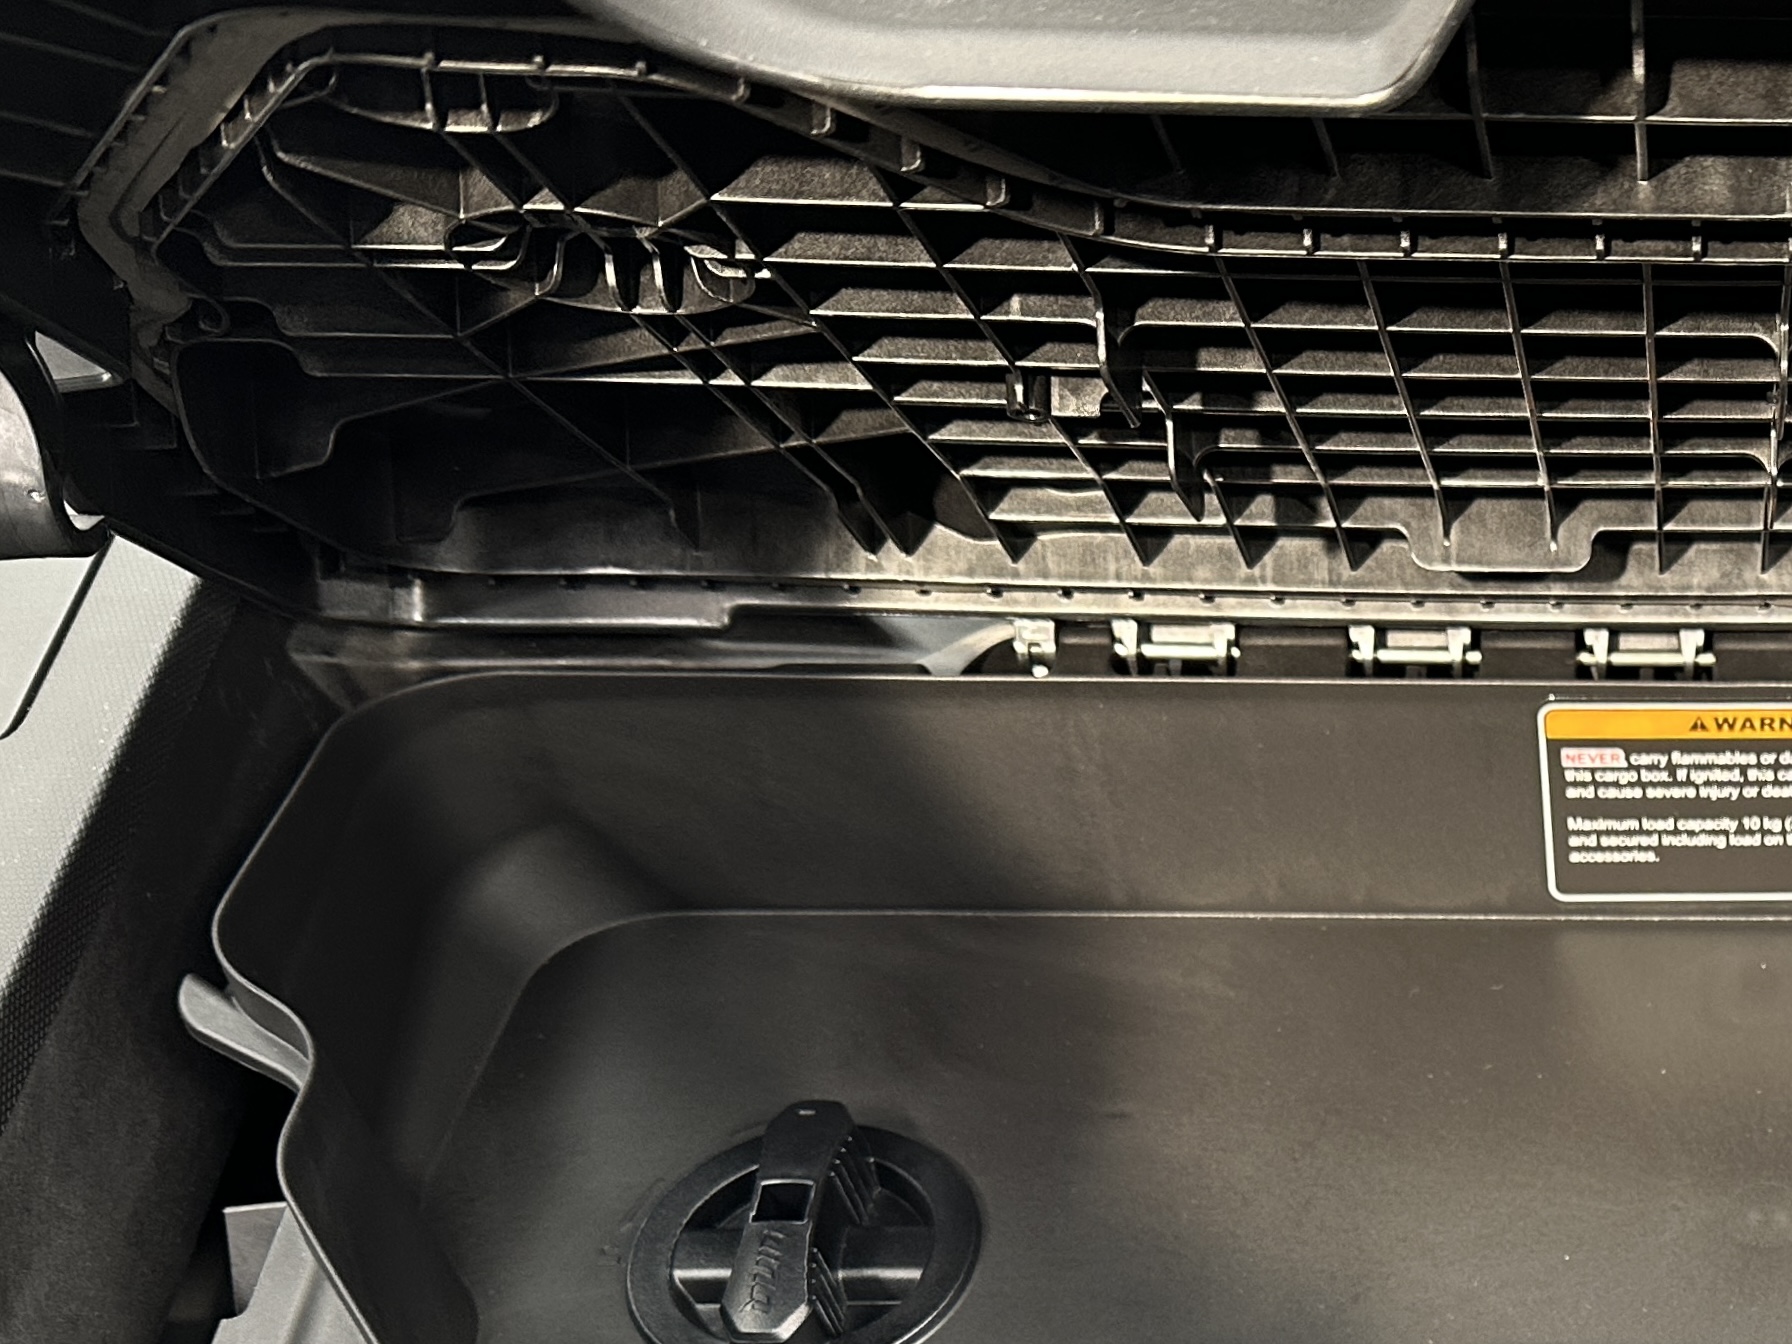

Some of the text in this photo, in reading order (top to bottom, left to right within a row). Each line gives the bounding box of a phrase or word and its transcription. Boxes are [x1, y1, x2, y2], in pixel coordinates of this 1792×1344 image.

[1565, 752, 1622, 765] NEVER
[1629, 753, 1669, 768] carry
[1671, 751, 1758, 765] flammables
[1760, 752, 1777, 765] or
[1564, 768, 1593, 783] this
[1594, 770, 1638, 785] cargo
[1640, 768, 1673, 782] box.
[1689, 768, 1744, 784] ignited,
[1747, 768, 1775, 782] this
[1565, 785, 1596, 799] and
[1597, 787, 1643, 799] cause
[1645, 786, 1697, 799] severe
[1699, 785, 1741, 801] injury
[1742, 786, 1760, 799] or
[1567, 816, 1640, 831] Maximum
[1641, 816, 1675, 831] load
[1676, 816, 1739, 833] capacity
[1742, 815, 1761, 830] 10
[1763, 816, 1783, 833] kg
[1568, 833, 1598, 847] and
[1600, 833, 1659, 847] secured
[1661, 833, 1727, 849] including
[1729, 832, 1762, 846] load
[1763, 834, 1784, 846] on
[1568, 850, 1660, 863] accessories.
